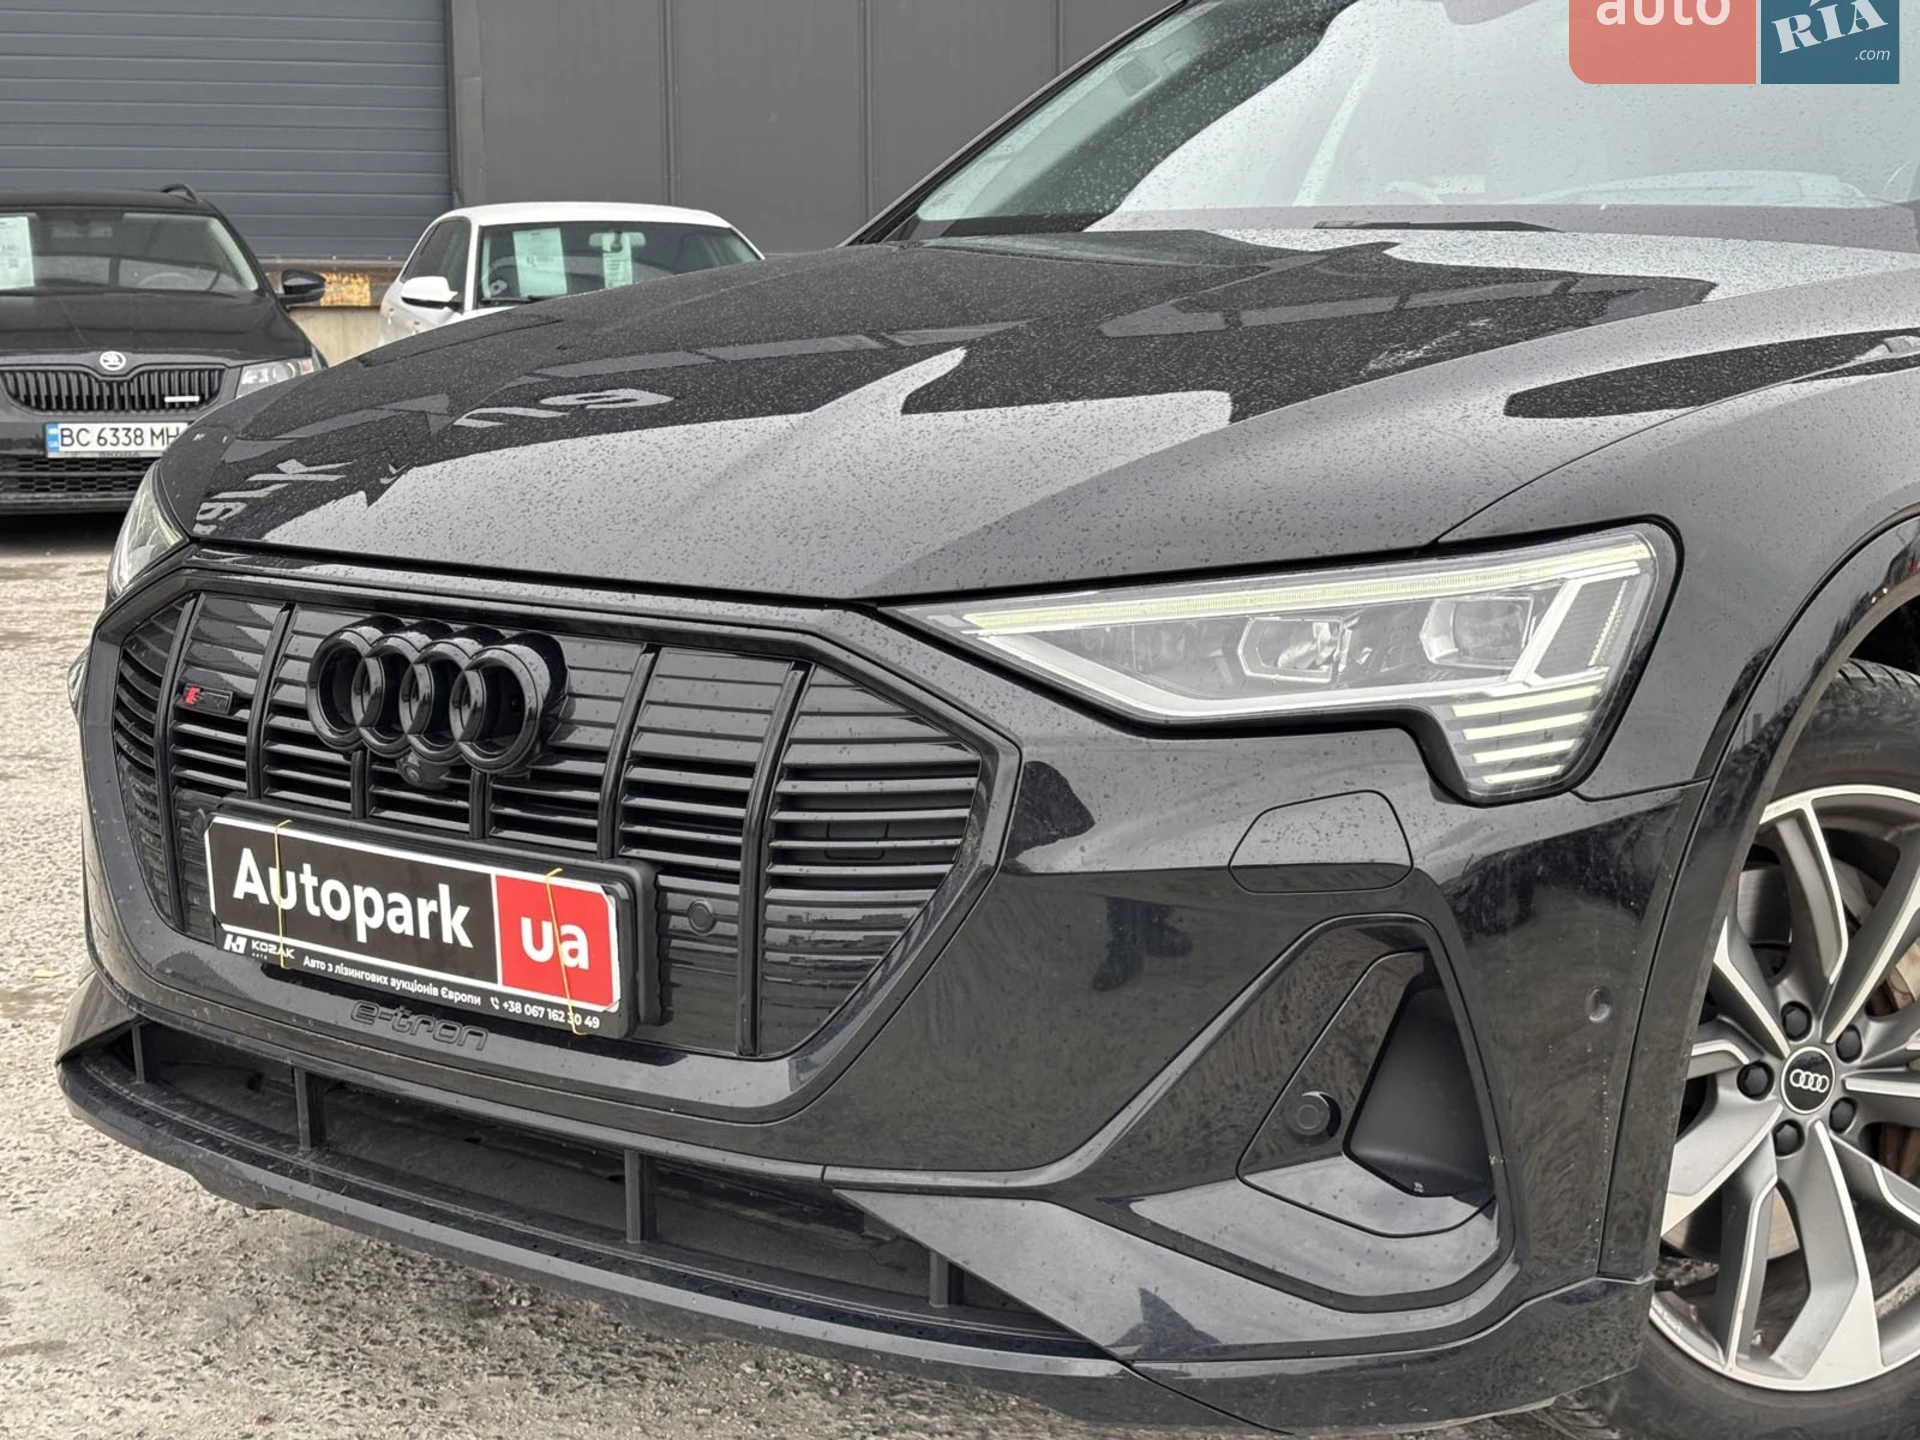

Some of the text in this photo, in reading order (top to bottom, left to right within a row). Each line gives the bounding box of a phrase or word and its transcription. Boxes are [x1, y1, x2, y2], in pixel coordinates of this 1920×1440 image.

[60, 427, 180, 447] BC 6338 MH
[233, 847, 590, 971] Autopark ua
[303, 955, 326, 971] Авто
[334, 962, 389, 986] лізингових
[390, 976, 439, 998] аукціонів
[441, 987, 482, 1008] Європи
[350, 999, 490, 1052] e-tron
[502, 1001, 522, 1014] +38
[524, 1004, 546, 1019] 067
[547, 1008, 566, 1023] 162
[584, 1015, 600, 1029] 49
